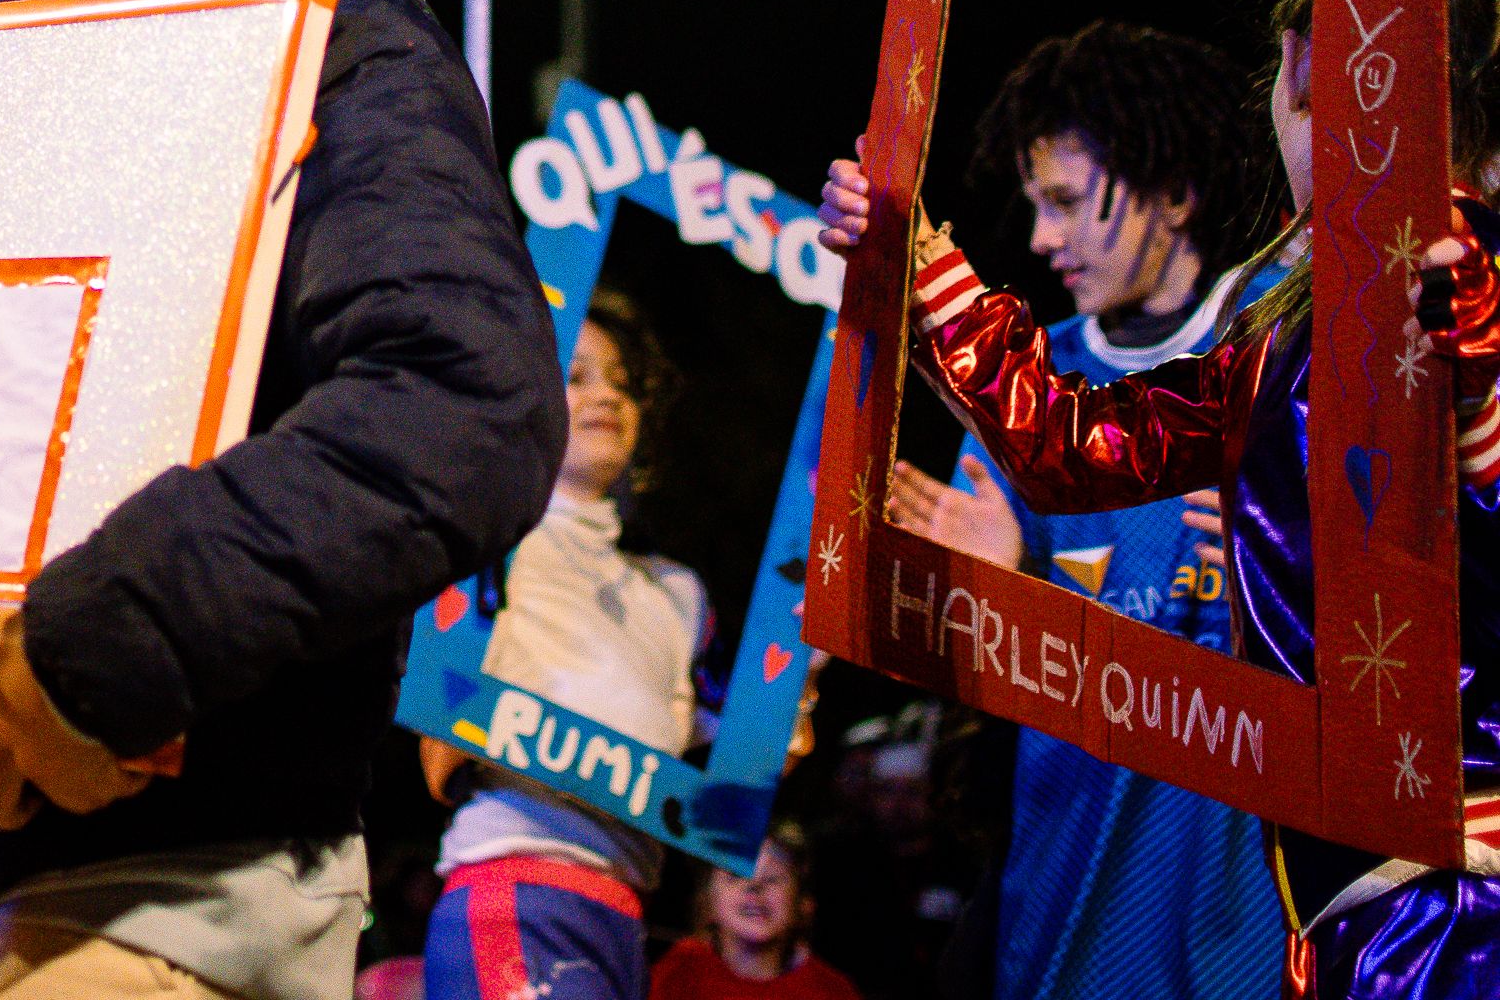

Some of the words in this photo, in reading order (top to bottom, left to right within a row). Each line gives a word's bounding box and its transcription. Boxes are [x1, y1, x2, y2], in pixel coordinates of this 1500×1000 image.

[510, 92, 668, 232] QUI
[670, 128, 776, 274] ÉS
[891, 559, 1089, 707] HARLEY
